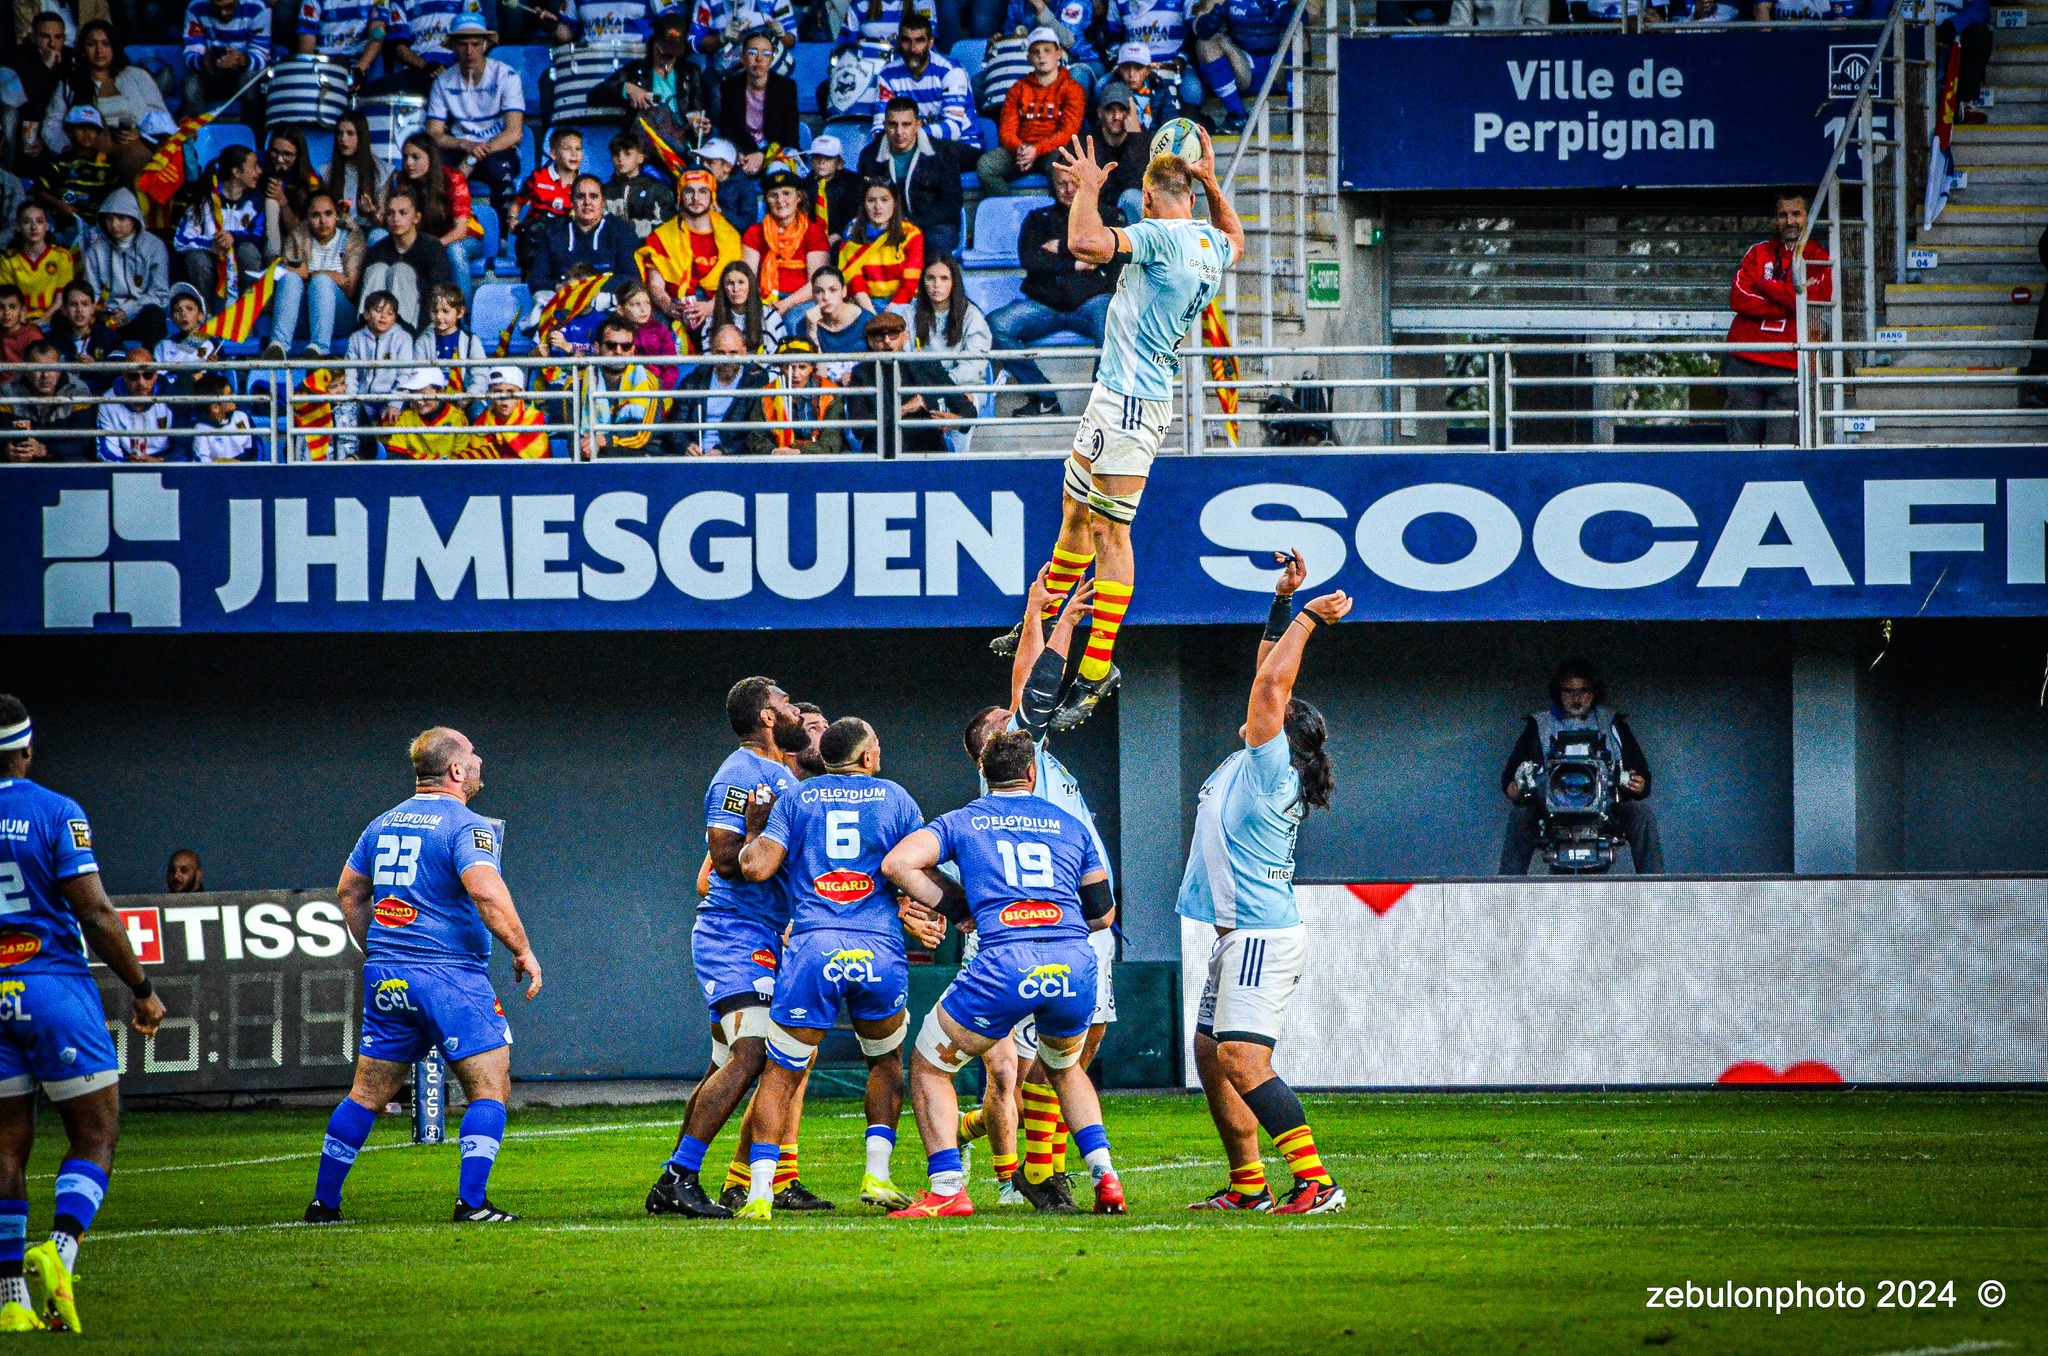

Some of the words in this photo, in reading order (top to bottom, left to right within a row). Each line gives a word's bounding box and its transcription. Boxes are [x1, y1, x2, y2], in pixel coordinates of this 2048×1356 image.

[1506, 59, 1614, 101] Ville
[1628, 58, 1684, 99] de
[1153, 133, 1171, 157] ERT
[1474, 110, 1714, 161] Perpignan
[1911, 250, 1933, 258] RANG
[1916, 259, 1929, 267] 04
[730, 789, 748, 799] TOP
[820, 788, 886, 800] ELGYDIUM
[0, 818, 30, 834] IUM
[394, 811, 443, 826] ELGYDIUM
[991, 815, 1061, 830] ELGYDIUM
[825, 810, 861, 860] 6
[373, 834, 422, 886] 23
[996, 840, 1054, 888] 19
[817, 879, 870, 893] BIGARD
[1004, 908, 1058, 922] BIGARD
[163, 901, 363, 960] TISS
[823, 962, 882, 983] CCL
[1018, 977, 1077, 999] CCL
[374, 991, 418, 1012] CCL
[426, 1063, 438, 1084] DU
[426, 1088, 439, 1118] SUD
